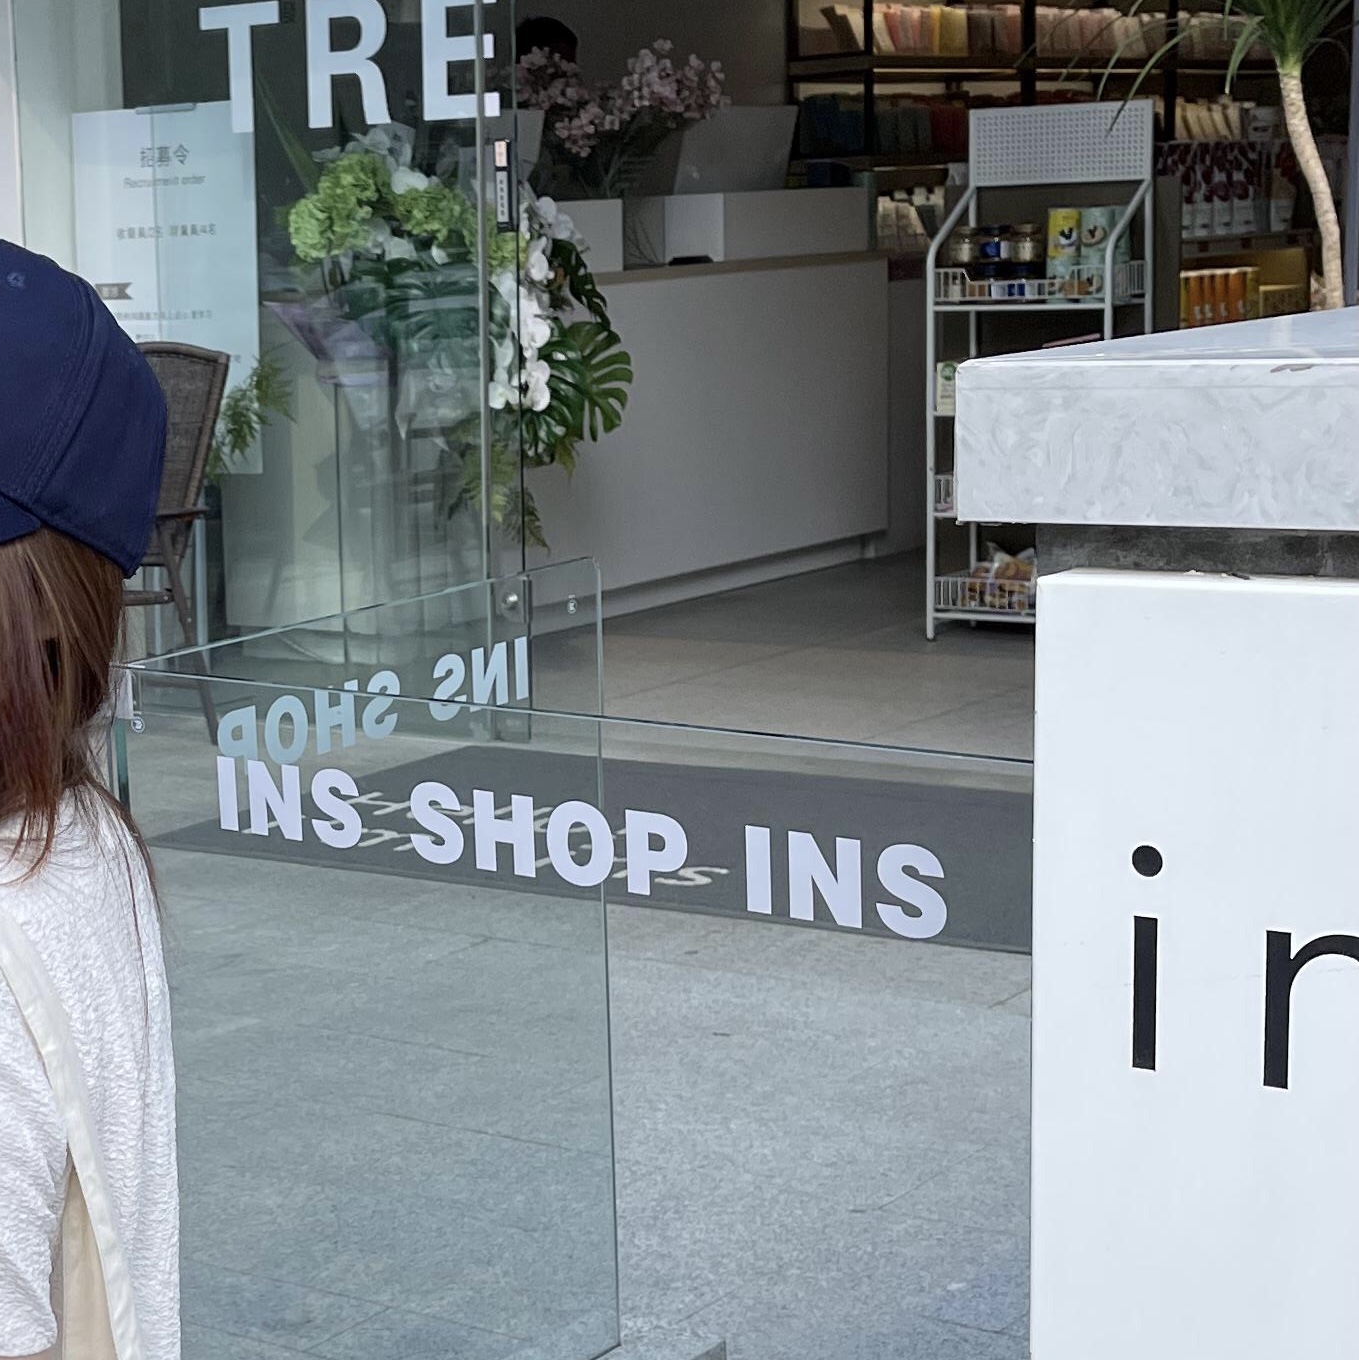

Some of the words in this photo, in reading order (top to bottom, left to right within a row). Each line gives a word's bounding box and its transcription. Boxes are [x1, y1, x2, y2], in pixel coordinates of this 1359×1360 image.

[216, 755, 363, 849] INS
[410, 781, 688, 896] SHOP
[745, 824, 948, 939] INS
